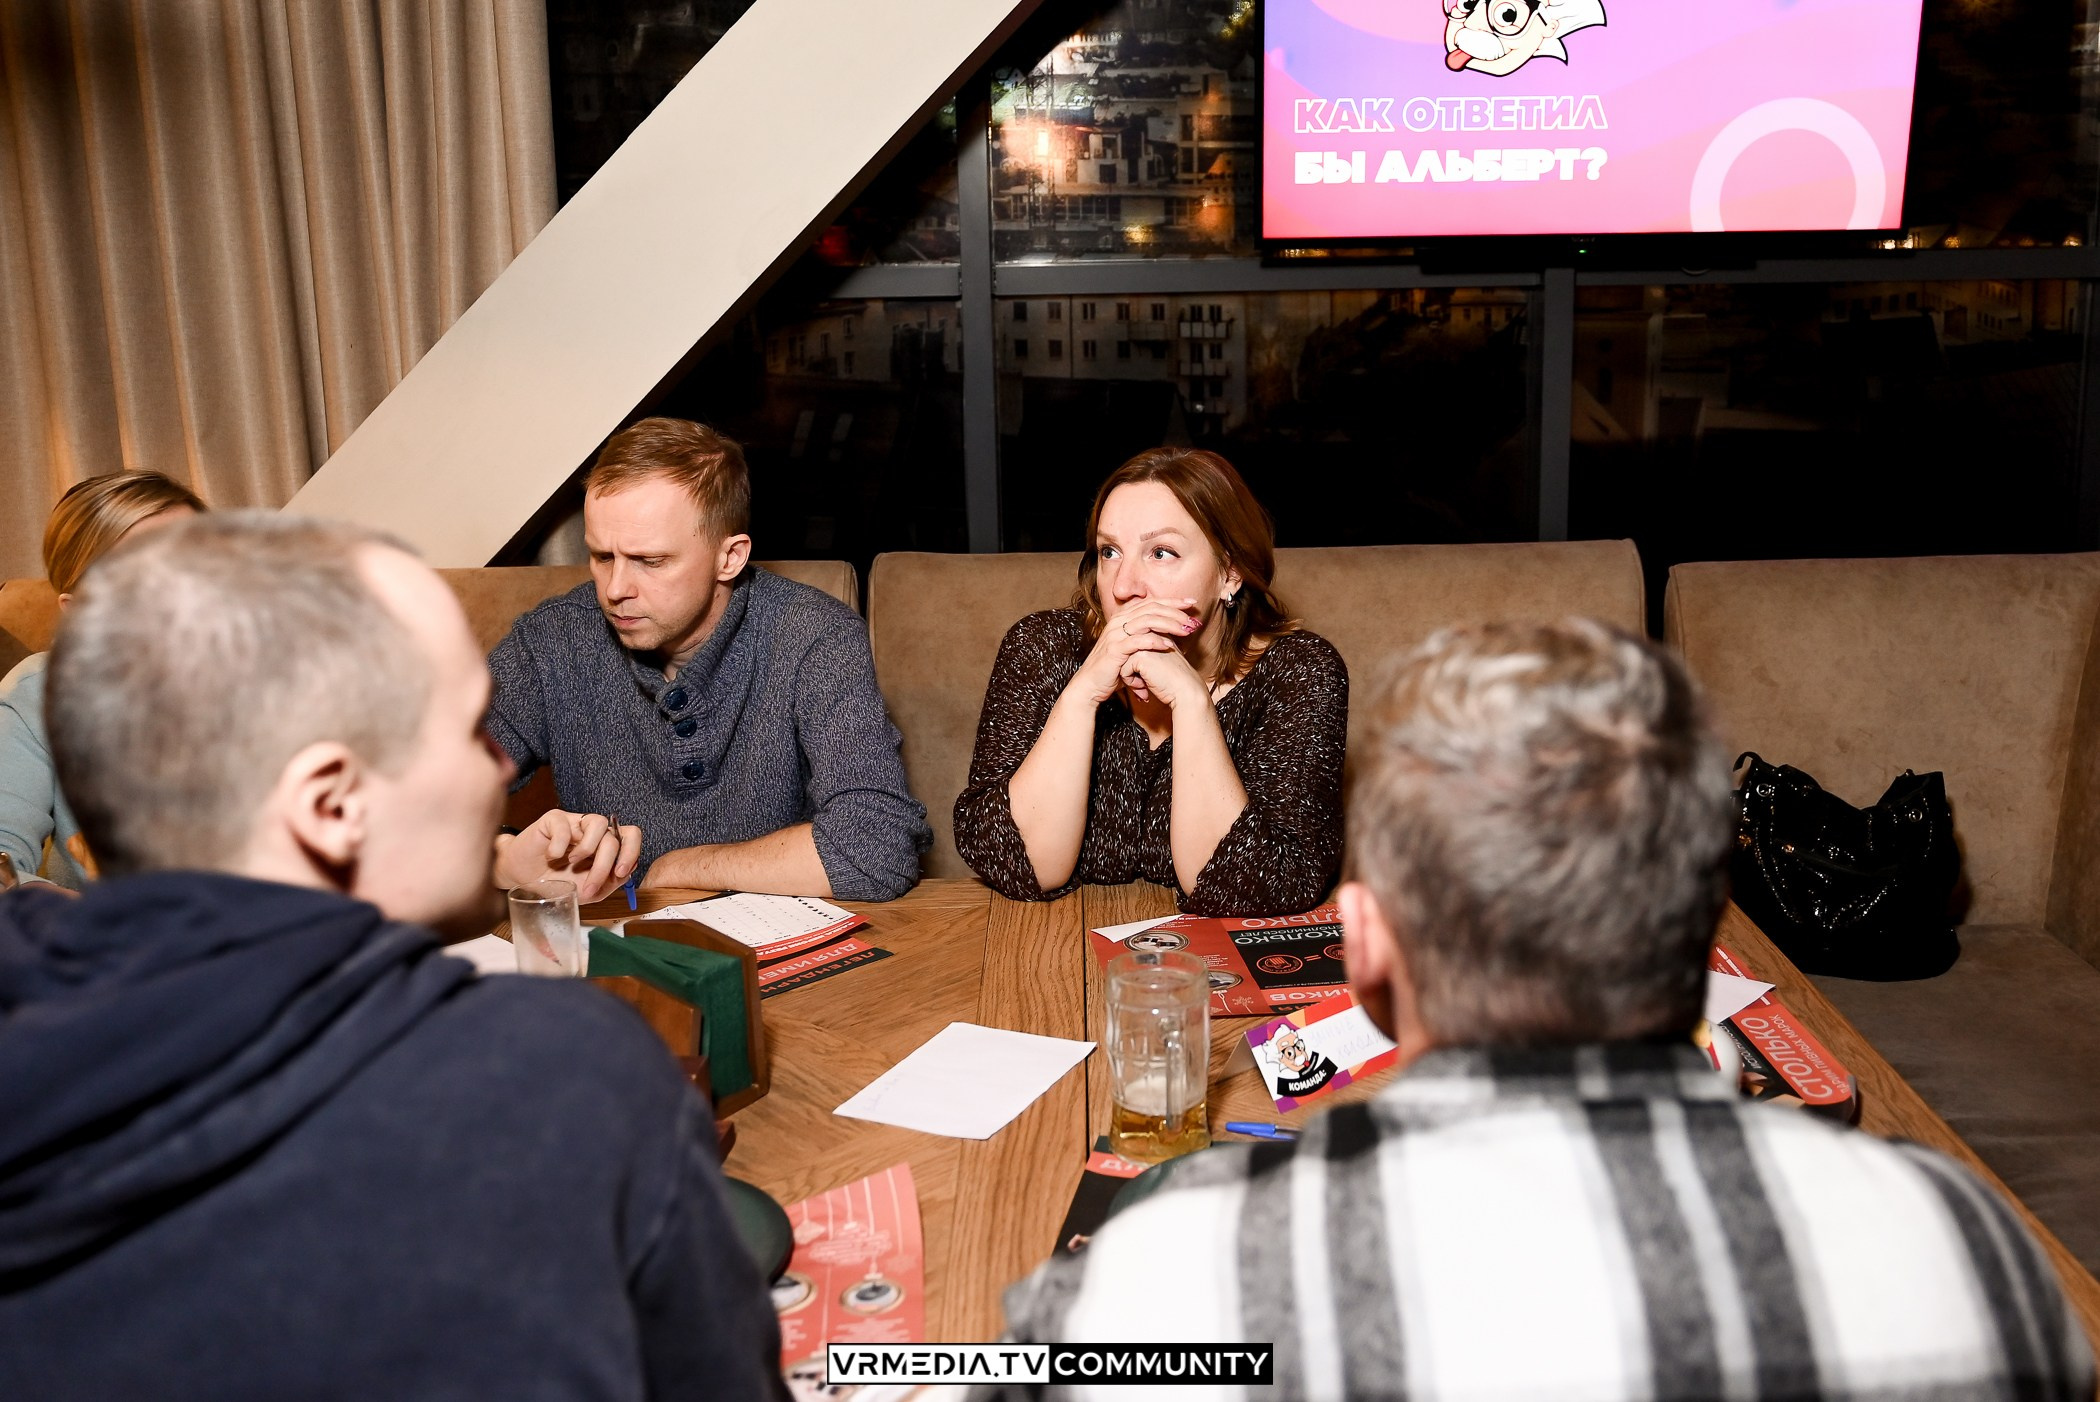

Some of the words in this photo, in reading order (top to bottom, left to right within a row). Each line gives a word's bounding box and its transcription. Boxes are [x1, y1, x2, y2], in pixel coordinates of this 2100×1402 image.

[1295, 98, 1395, 133] КАК
[1403, 95, 1608, 132] ОТВЕТИЛ
[1295, 151, 1366, 184] БЫ
[1374, 147, 1608, 183] АЛЬБЕРТ?
[1235, 929, 1345, 944] КОЛЬКО
[1263, 925, 1344, 935] СПОЛНИЛОСЬ
[811, 943, 858, 962] ДЛЯ
[760, 951, 875, 993] ЛЕГЕНДАРН
[1768, 1013, 1797, 1039] МАРОК
[1741, 1017, 1833, 1098] СТОЛЬКО
[1288, 1069, 1327, 1092] КОМАНДА:
